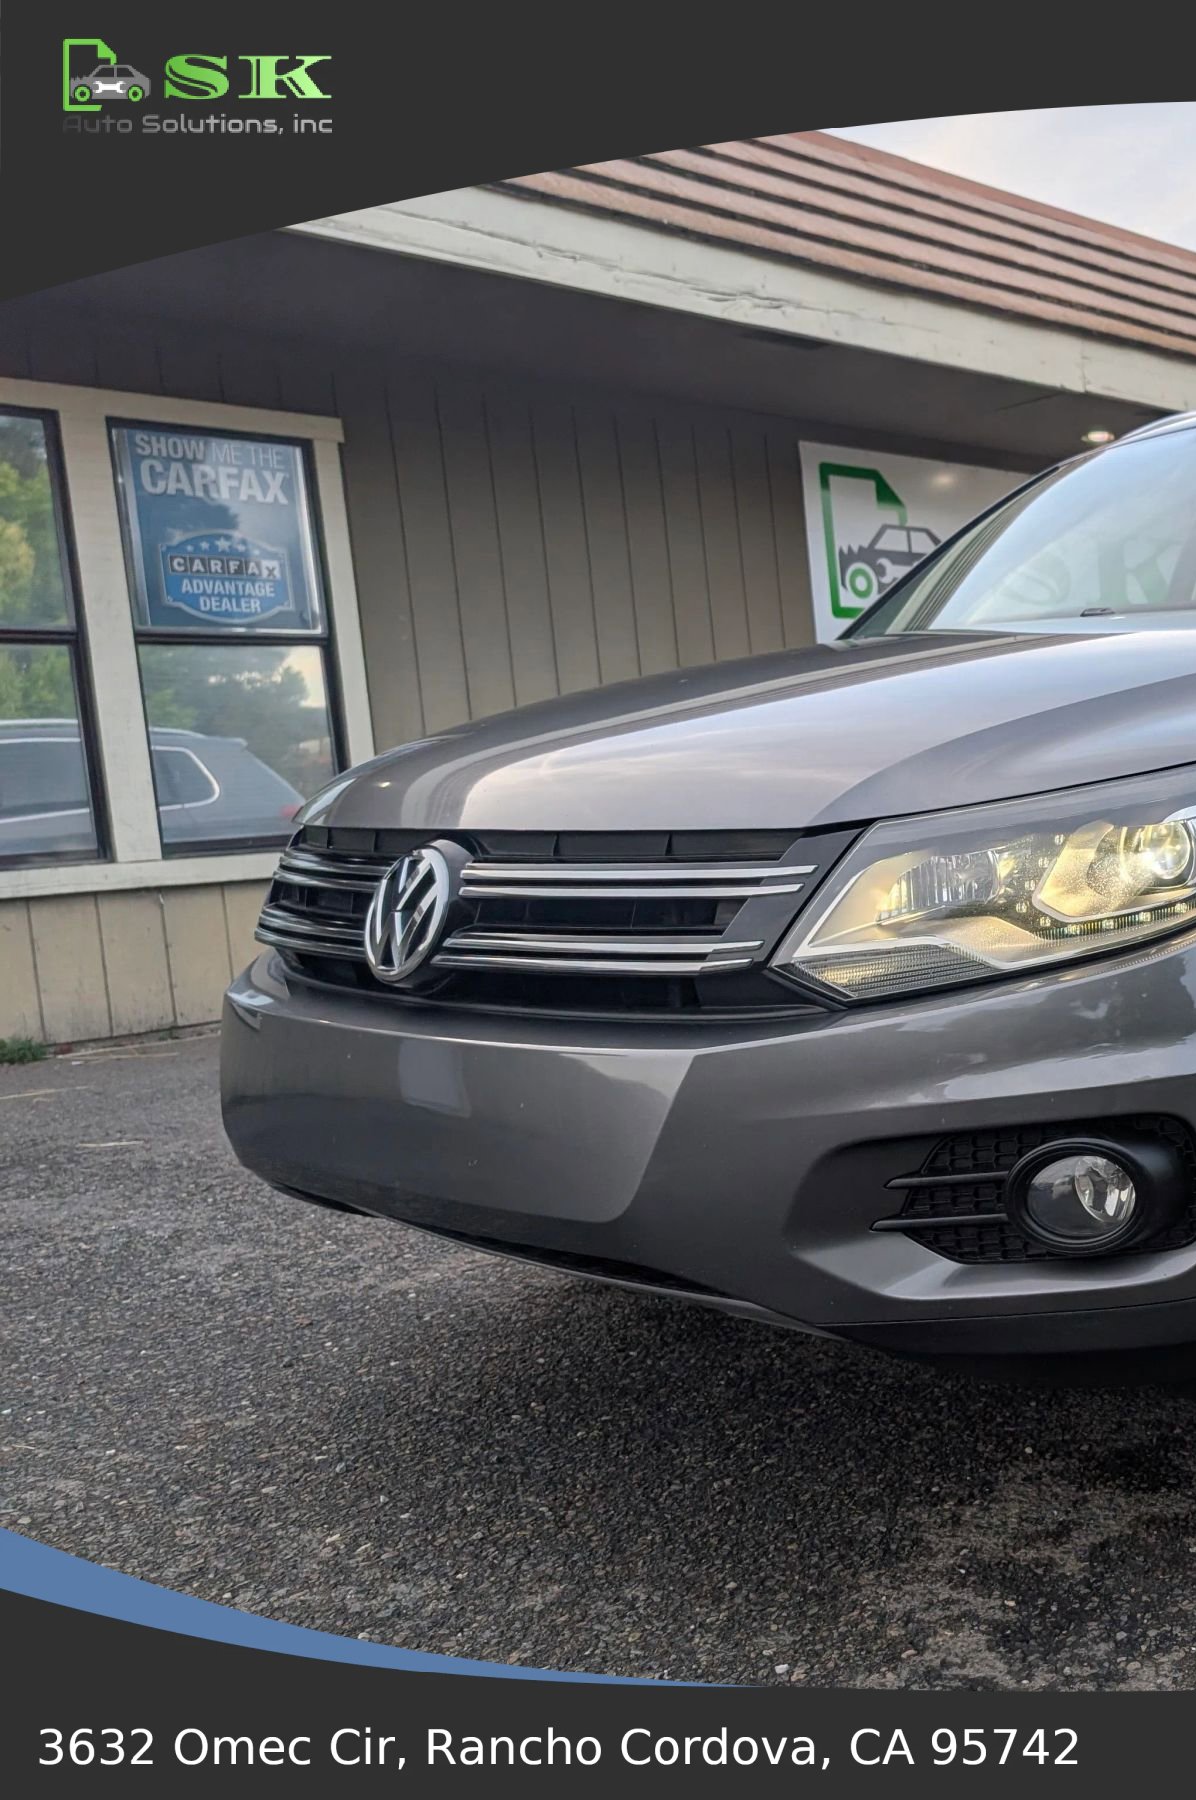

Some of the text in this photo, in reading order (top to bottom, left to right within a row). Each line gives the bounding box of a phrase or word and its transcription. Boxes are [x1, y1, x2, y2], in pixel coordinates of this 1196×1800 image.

[134, 433, 286, 469] SHOW ME THE
[139, 458, 289, 505] CARFAX
[170, 555, 281, 580] CARFAX
[180, 578, 276, 598] ADVANTAGE
[199, 596, 262, 614] DEALER
